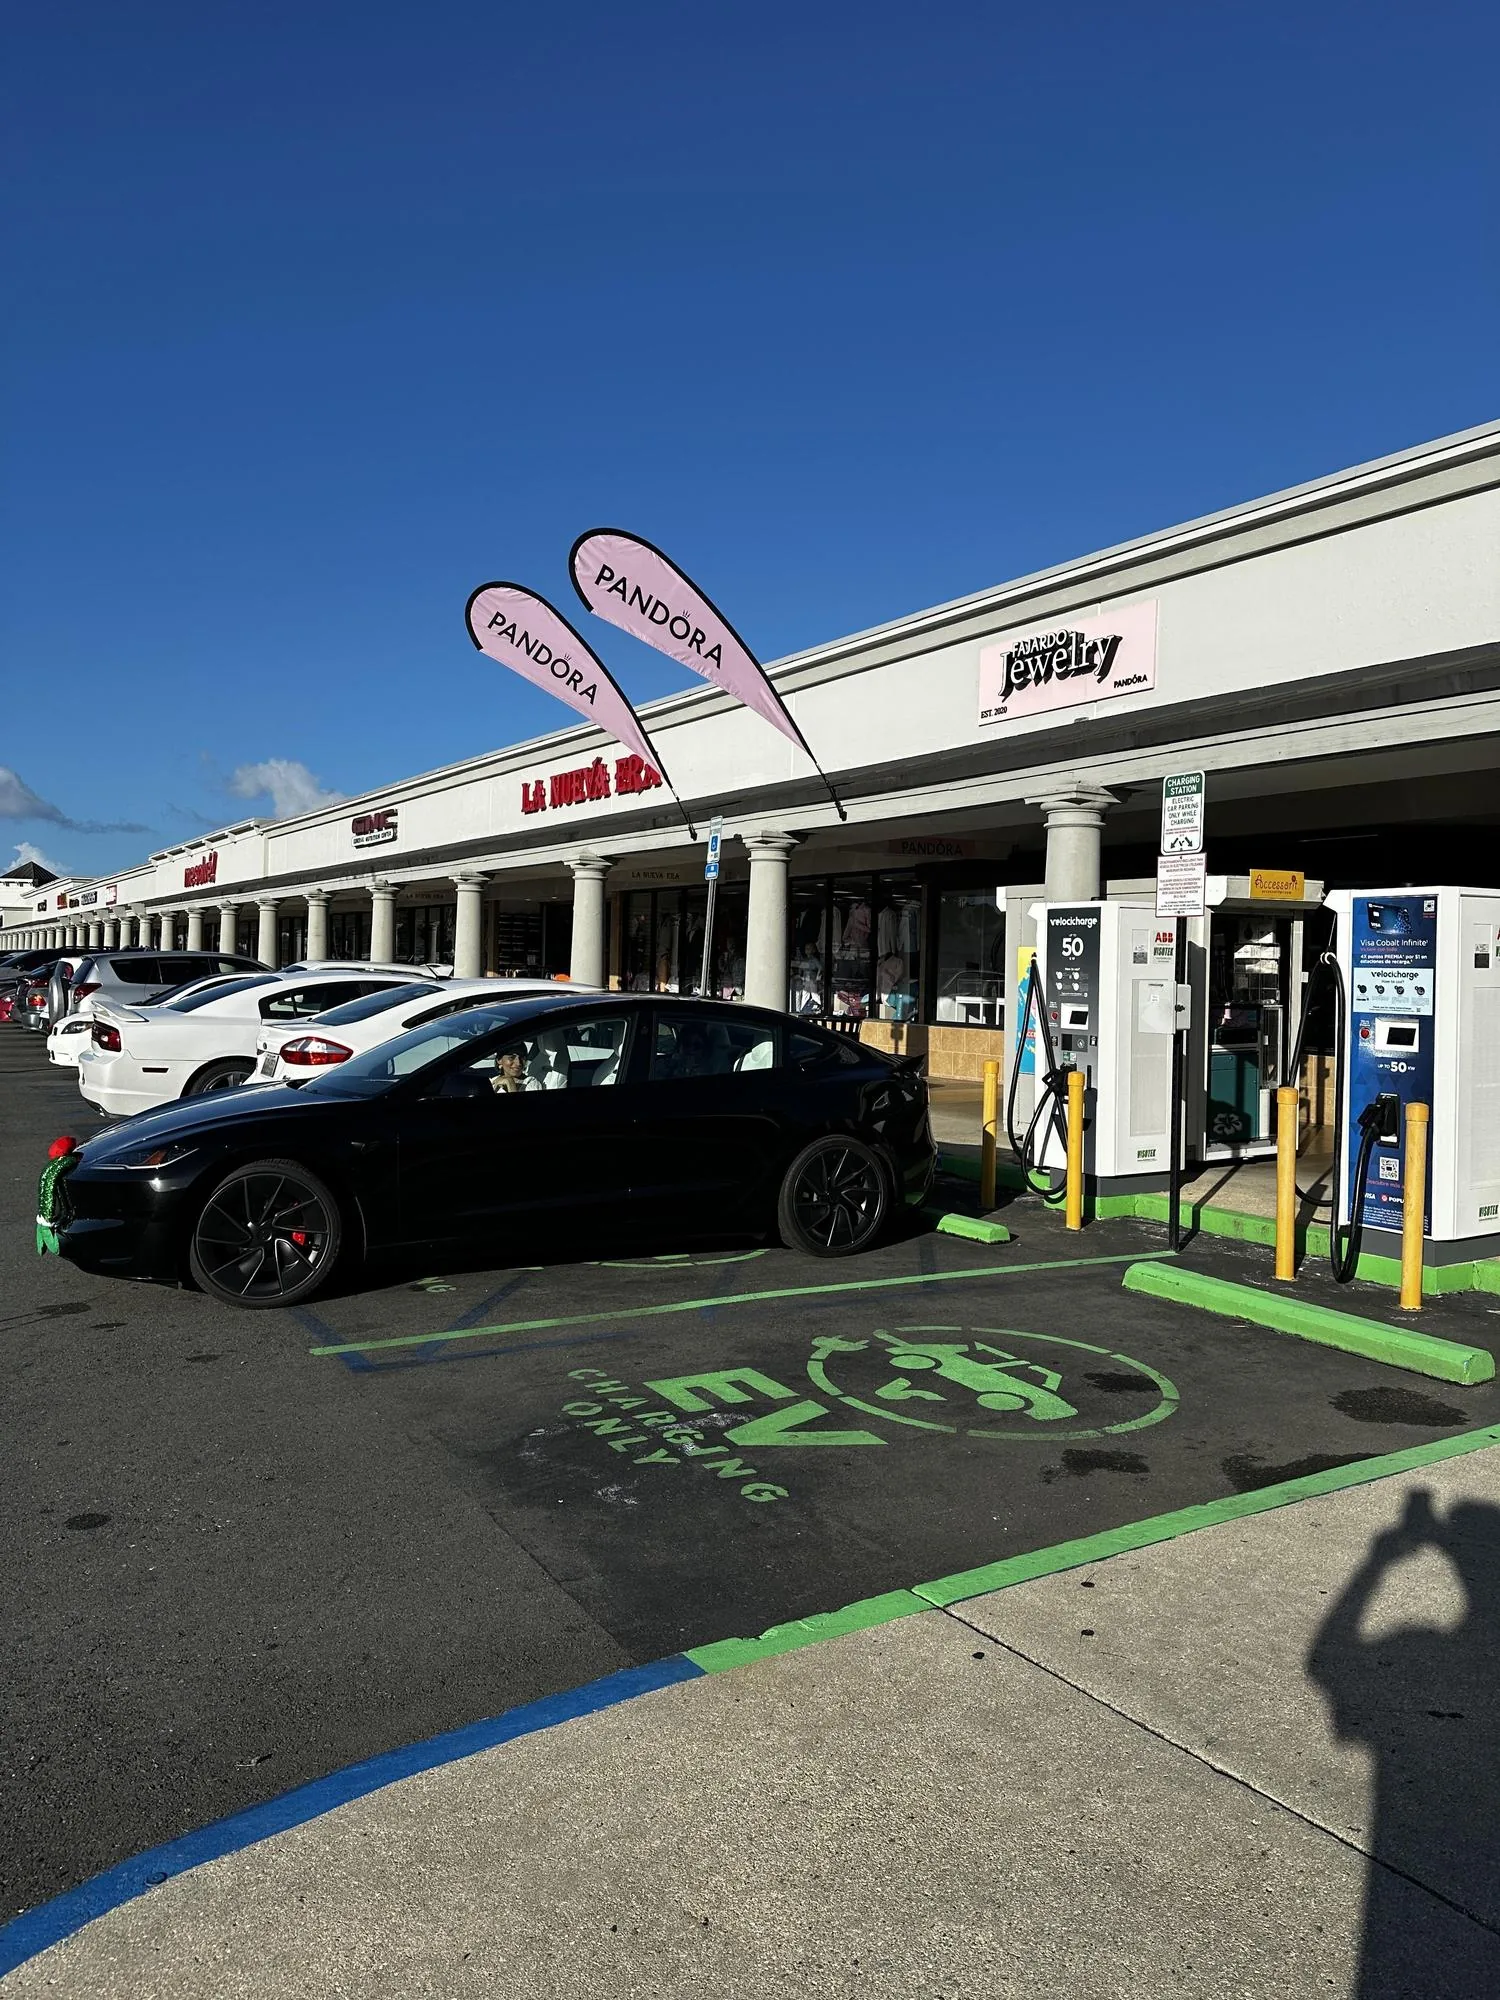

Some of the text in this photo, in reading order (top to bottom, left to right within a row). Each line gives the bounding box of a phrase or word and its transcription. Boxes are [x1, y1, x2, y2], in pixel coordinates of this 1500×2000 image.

[594, 563, 723, 669] PANDORA
[1011, 629, 1069, 659] FAJARDO
[487, 611, 600, 705] PANDORA
[998, 632, 1122, 702] Jewelry
[980, 706, 1008, 718] EST. 2020
[1167, 775, 1200, 787] CHARGING
[1170, 784, 1197, 796] STATION
[521, 780, 546, 814] LA
[1172, 796, 1194, 805] ELECTRIC
[1178, 802, 1199, 810] PARKING
[1168, 809, 1197, 819] ONLY WHILE
[1170, 818, 1194, 826] CHARGING
[1050, 916, 1098, 928] velocicharge
[1155, 931, 1174, 943] ABB
[1375, 939, 1400, 947] Cobalt
[1061, 937, 1084, 957] 50
[1371, 970, 1419, 981] velocicharge
[1390, 1061, 1407, 1073] 50
[643, 1367, 889, 1446] EV
[561, 1401, 681, 1464] ONLY
[567, 1368, 789, 1502] CHARGING
